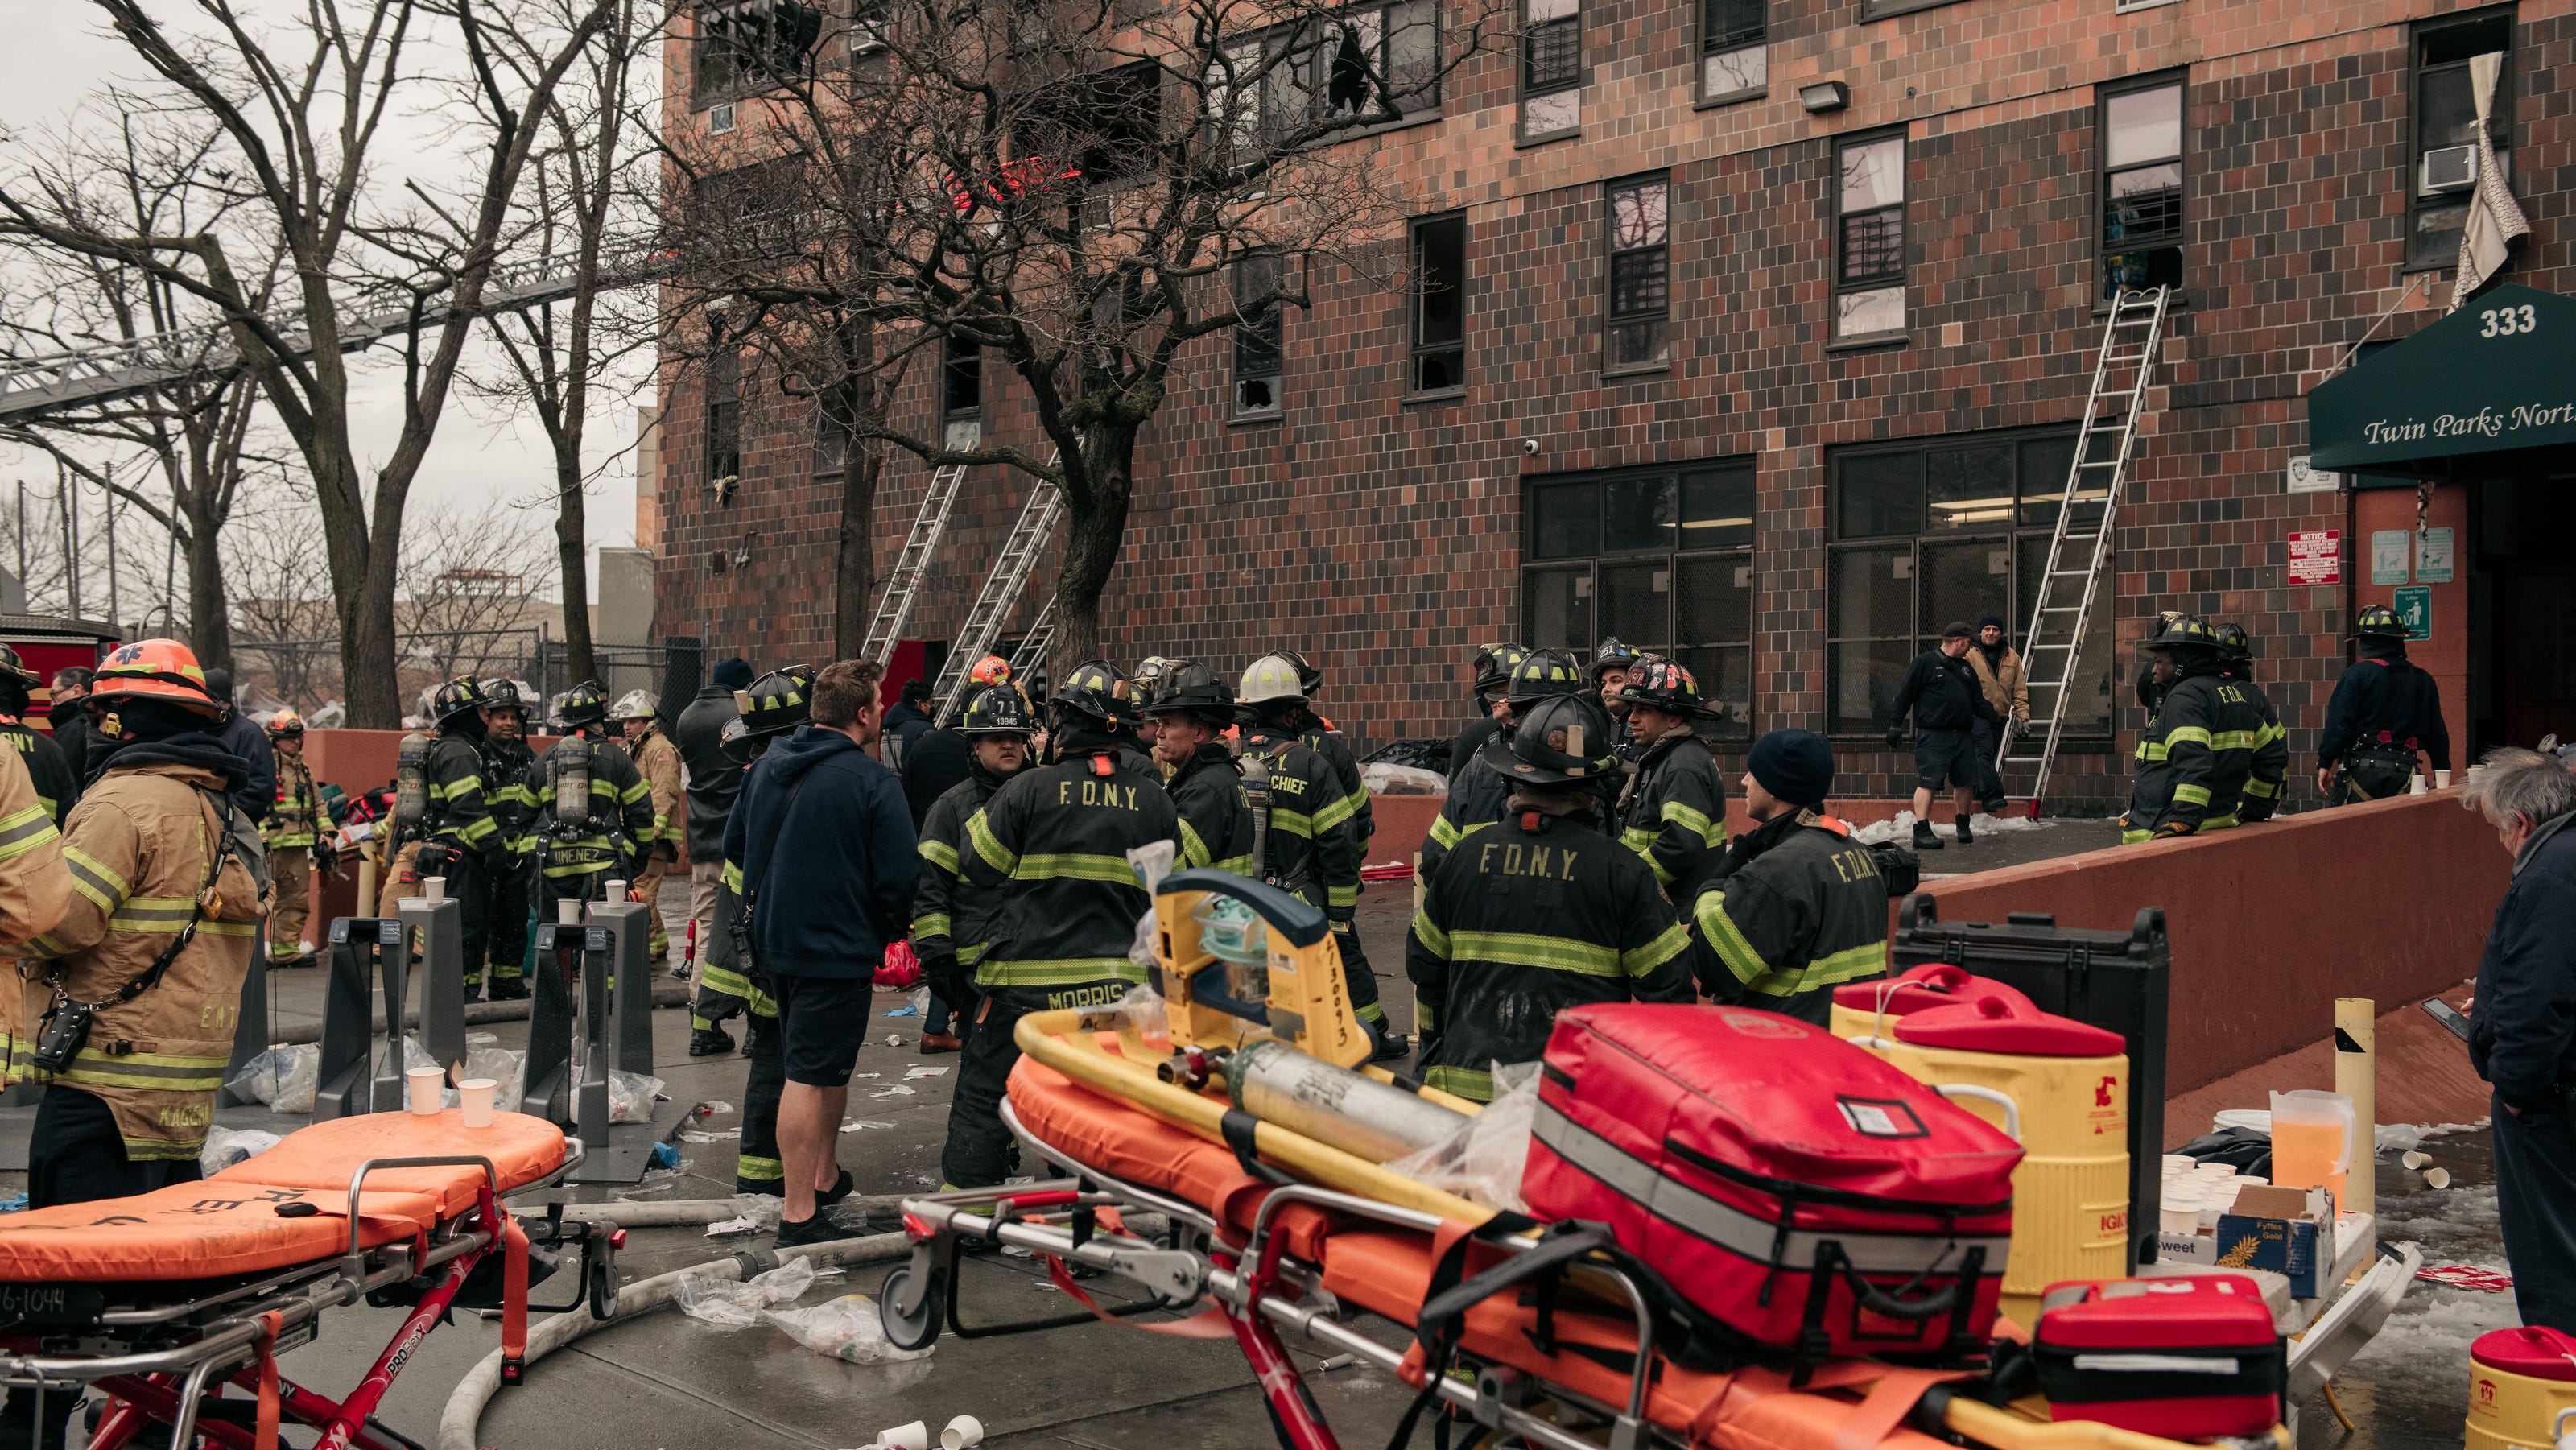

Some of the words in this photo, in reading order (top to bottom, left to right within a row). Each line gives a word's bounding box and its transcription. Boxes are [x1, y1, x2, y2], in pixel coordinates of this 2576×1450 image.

[2480, 304, 2536, 338] 333
[2364, 417, 2426, 444] Twin
[2433, 406, 2504, 437] Parks
[2508, 403, 2576, 431] Nort
[2300, 532, 2328, 541] NOTICE
[1600, 645, 1613, 659] 251
[501, 688, 514, 696] 97
[997, 717, 1018, 725] 13945
[1059, 780, 1140, 812] F.D.N.Y.
[1479, 843, 1579, 882] F.D.N.Y.
[1047, 984, 1125, 1010] MORRIS
[2256, 1221, 2284, 1232] Fyffes
[2262, 1231, 2284, 1241] Gold
